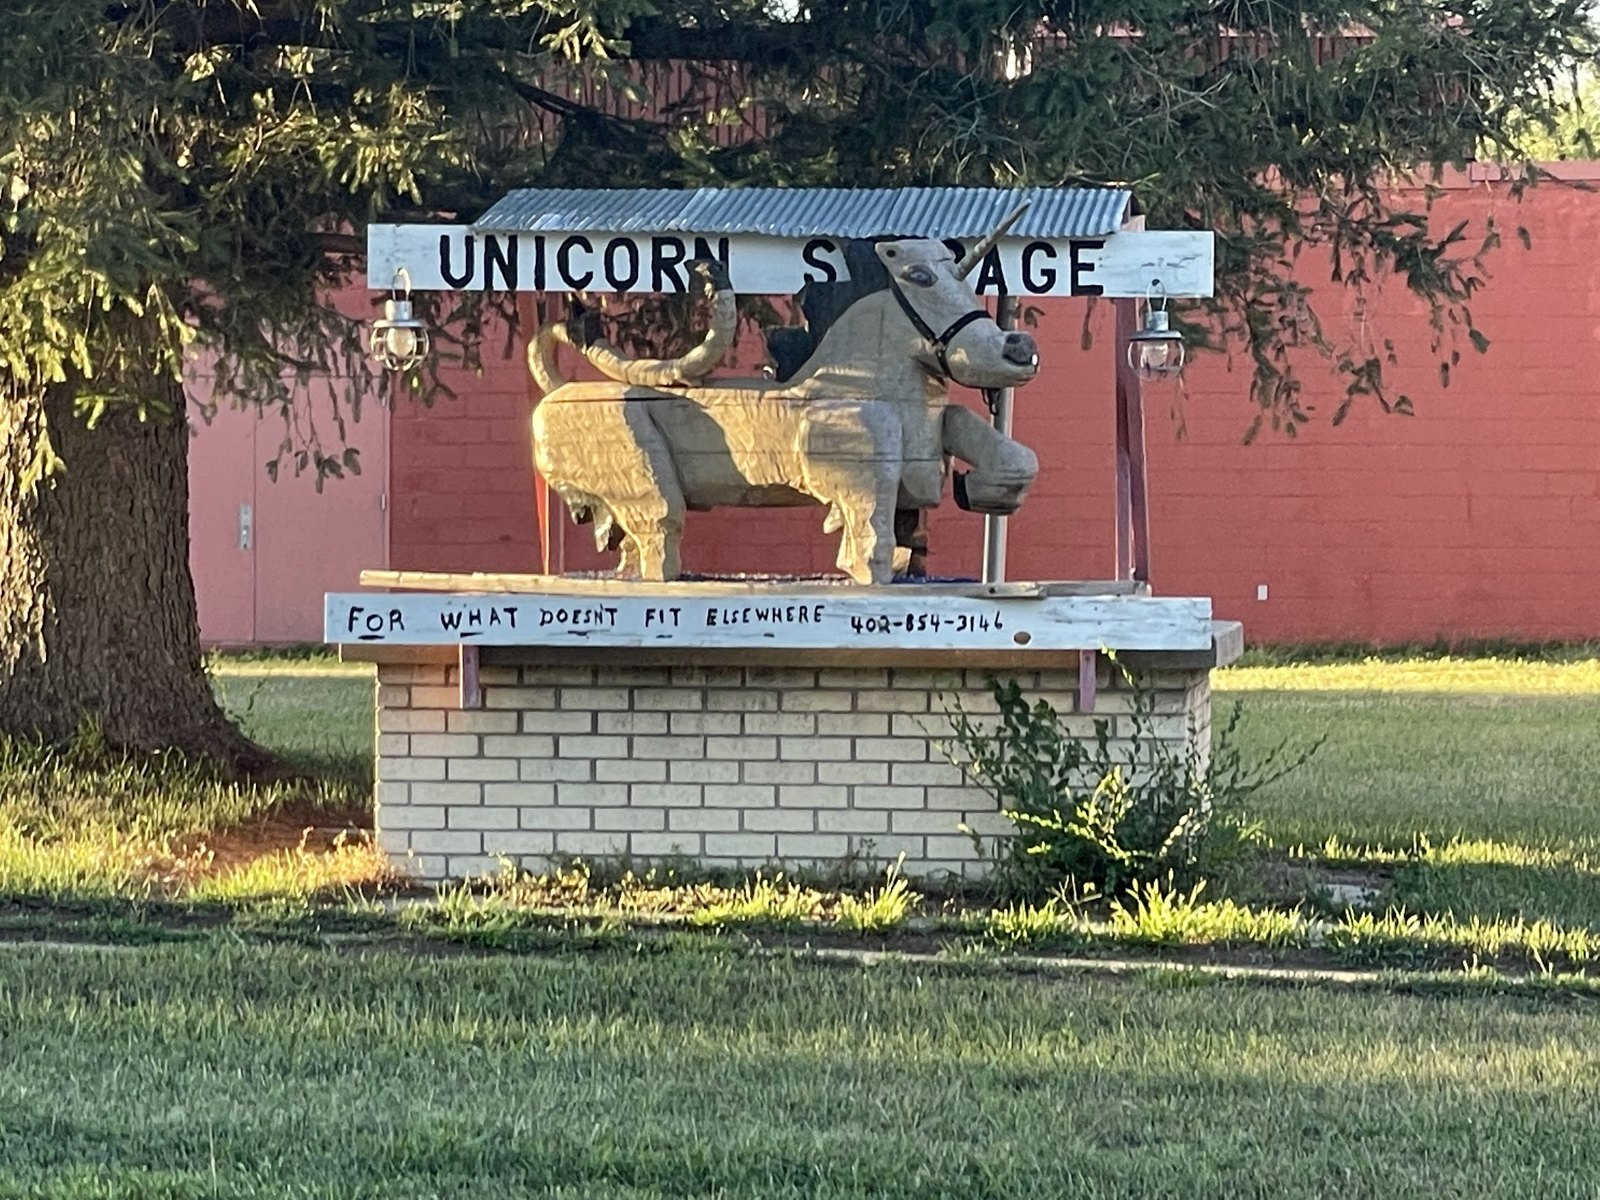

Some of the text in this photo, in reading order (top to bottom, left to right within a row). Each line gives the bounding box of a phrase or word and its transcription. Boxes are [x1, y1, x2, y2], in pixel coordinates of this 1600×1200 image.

[802, 237, 1105, 298] SAGE
[347, 606, 405, 633] FOR
[440, 606, 518, 630] WHAT
[645, 607, 682, 627] FIT
[707, 605, 826, 627] ELSEWHERE
[851, 611, 1004, 634] 402-854-3146
